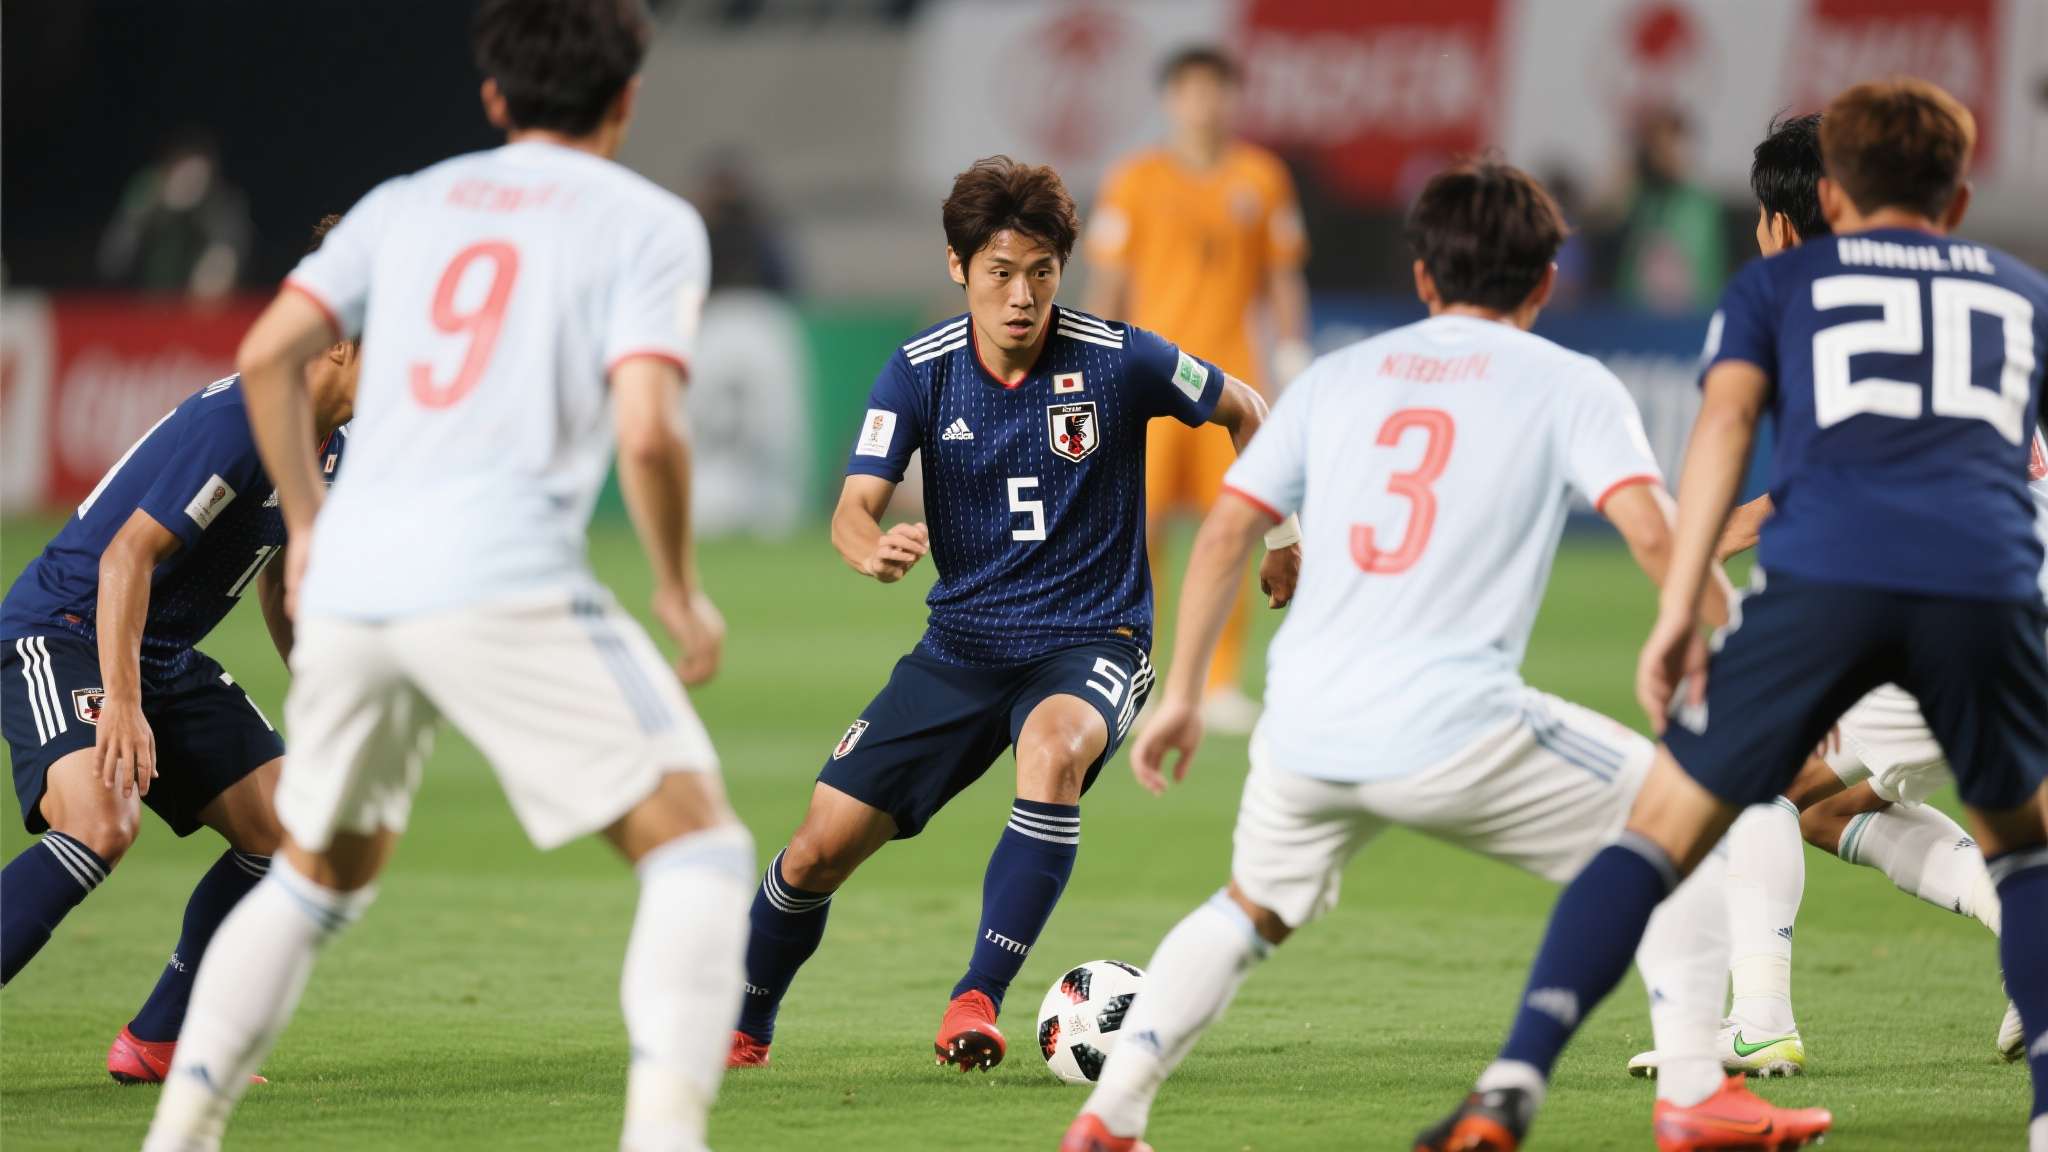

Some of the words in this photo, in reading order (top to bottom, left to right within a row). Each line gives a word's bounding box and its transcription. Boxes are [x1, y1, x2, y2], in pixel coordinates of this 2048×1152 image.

[410, 240, 521, 410] 9
[1811, 275, 2036, 446] 20
[1007, 476, 1046, 541] 5
[1349, 407, 1457, 577] 3
[1085, 657, 1128, 708] 5
